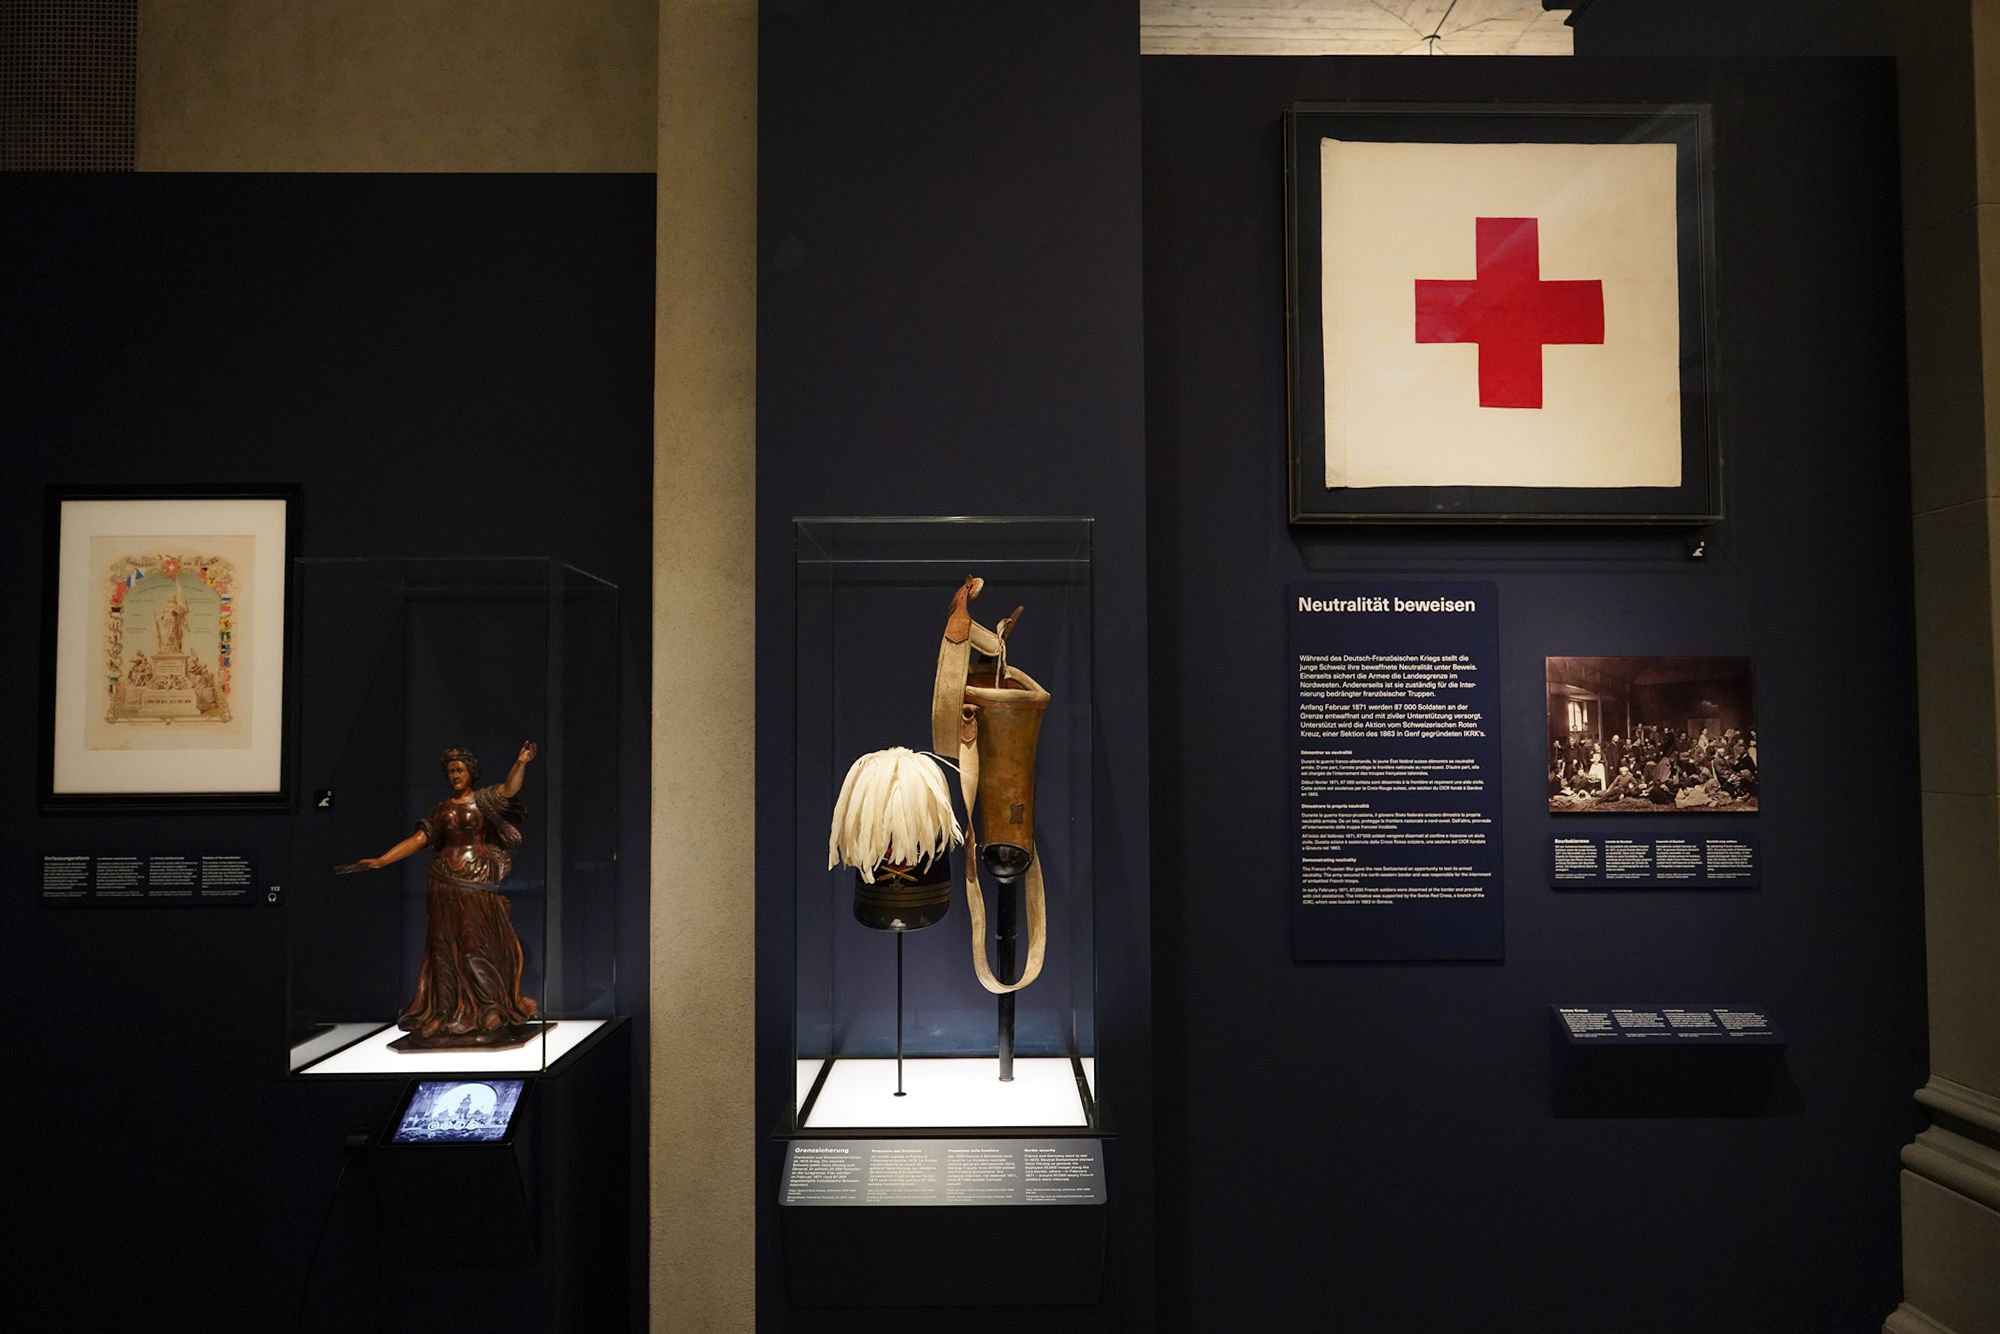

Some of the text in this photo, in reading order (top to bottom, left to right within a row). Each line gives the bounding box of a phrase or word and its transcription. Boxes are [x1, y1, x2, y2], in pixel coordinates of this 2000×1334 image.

[1298, 596, 1476, 612] Neutralität beweisen
[1420, 654, 1441, 663] Kriegs
[1300, 663, 1318, 672] junge
[1405, 680, 1436, 689] zuständig
[1300, 690, 1325, 698] nierung
[1326, 690, 1362, 698] bedrängter
[1407, 690, 1436, 698] Truppen.
[1300, 703, 1324, 712] Anfang
[1454, 712, 1482, 720] versorgt.
[1301, 730, 1321, 738] Kreuz,
[1421, 729, 1462, 738] gegründeten
